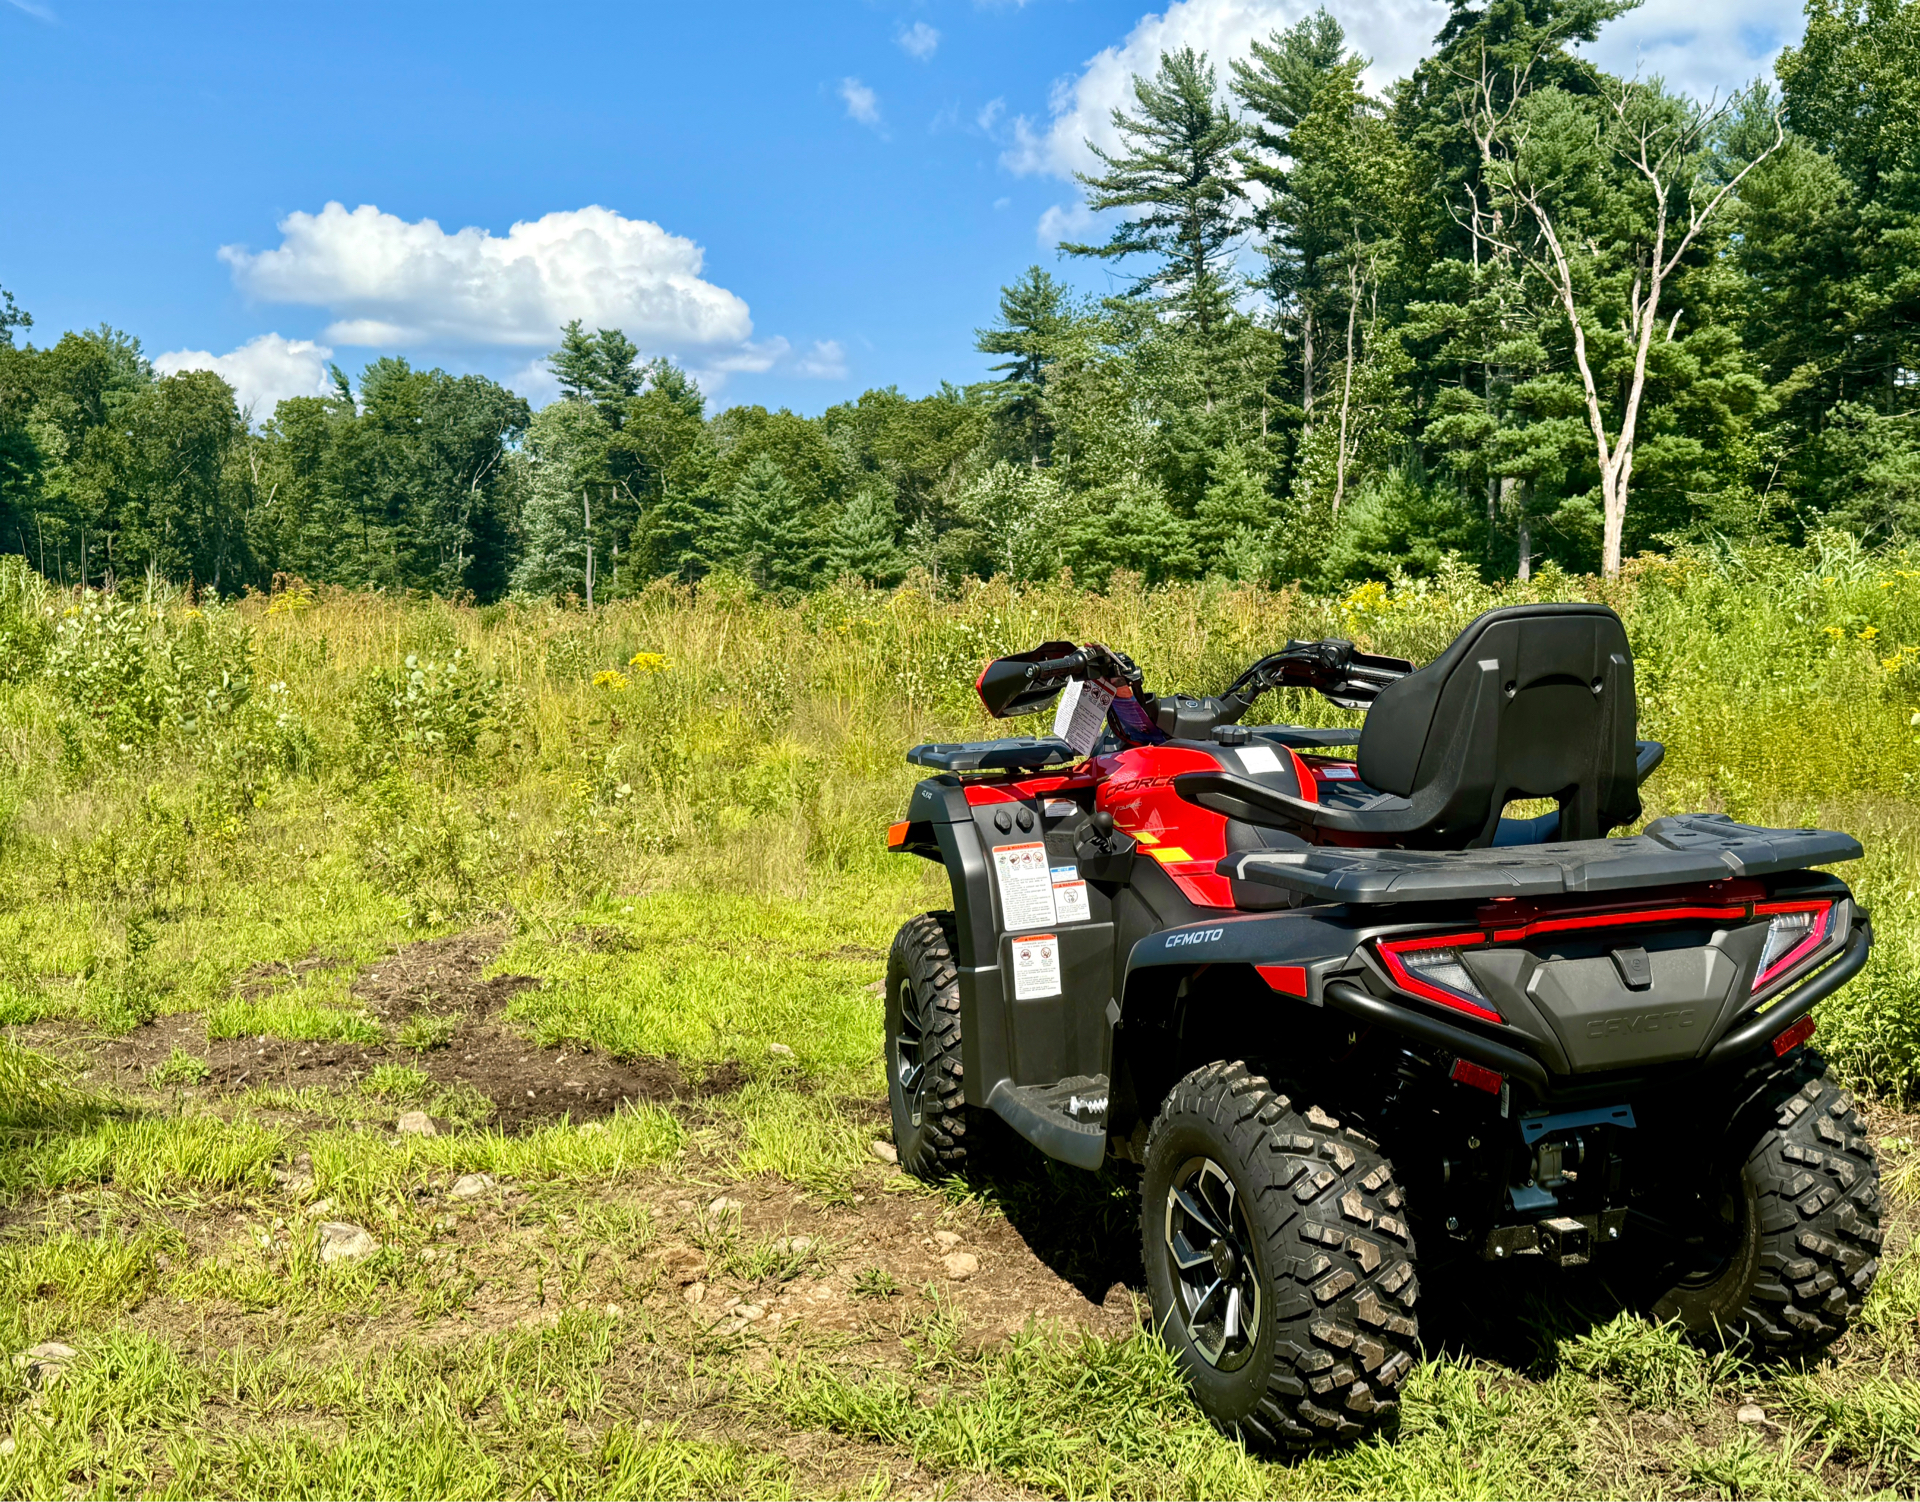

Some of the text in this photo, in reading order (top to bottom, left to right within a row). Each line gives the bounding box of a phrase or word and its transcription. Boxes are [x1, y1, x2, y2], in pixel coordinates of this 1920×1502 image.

[1105, 775, 1176, 800] CFORCE
[1165, 928, 1224, 948] CFMOTO
[1586, 1009, 1695, 1039] CFMOTO
